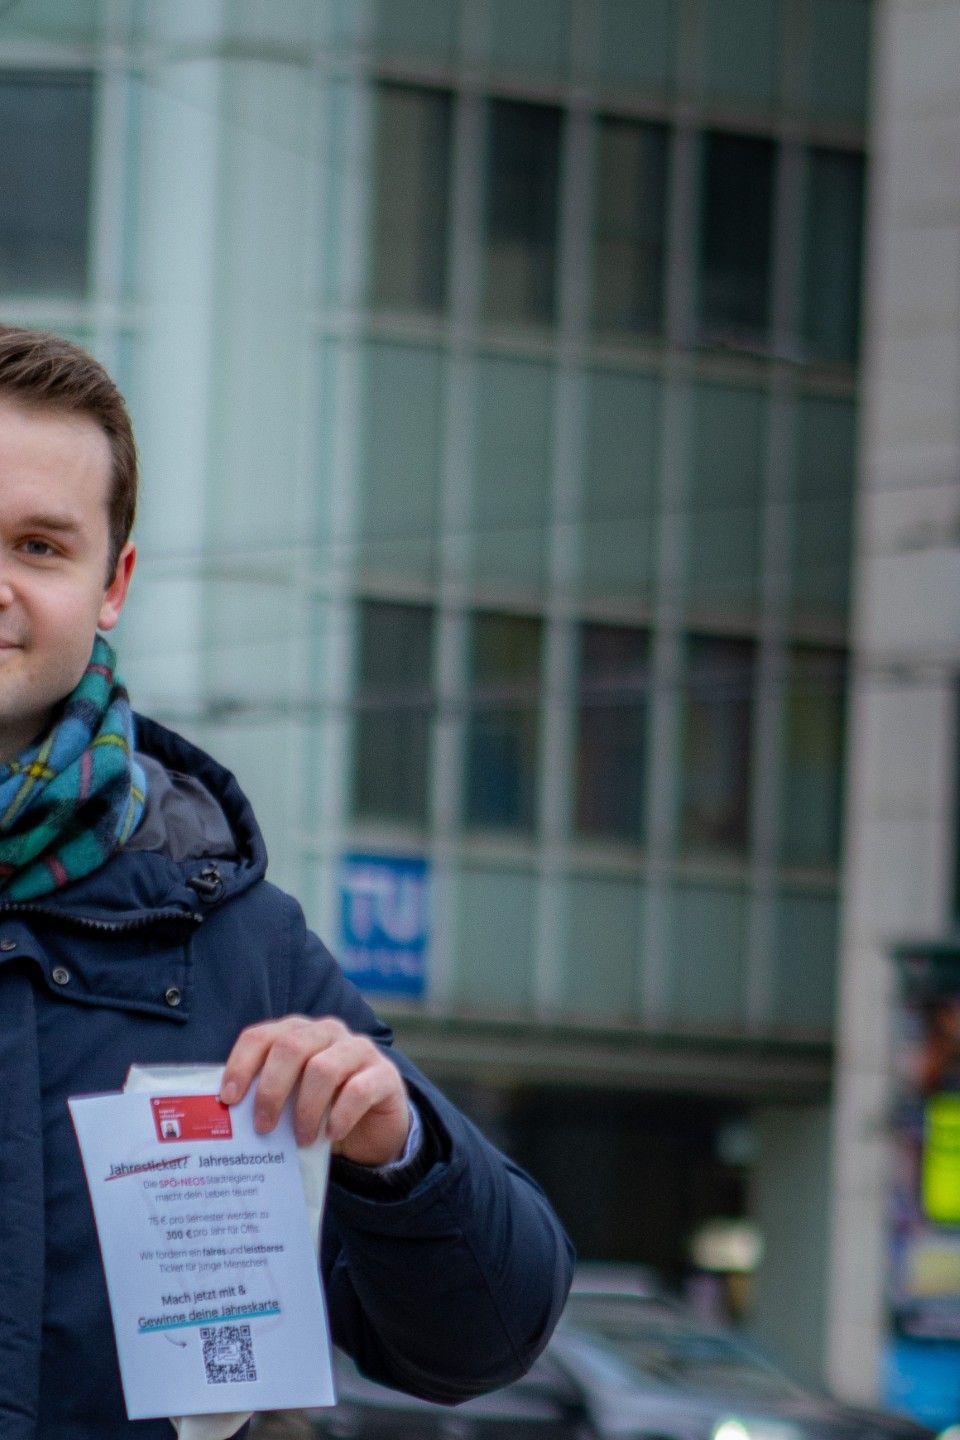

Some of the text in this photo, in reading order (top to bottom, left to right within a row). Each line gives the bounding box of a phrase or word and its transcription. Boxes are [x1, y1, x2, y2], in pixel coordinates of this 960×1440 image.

[166, 1229, 184, 1241] 300
[185, 1229, 193, 1239] €
[161, 1285, 246, 1306] Mach jetzt mit &
[138, 1299, 279, 1328] Gewinne deine Jahreskarte
